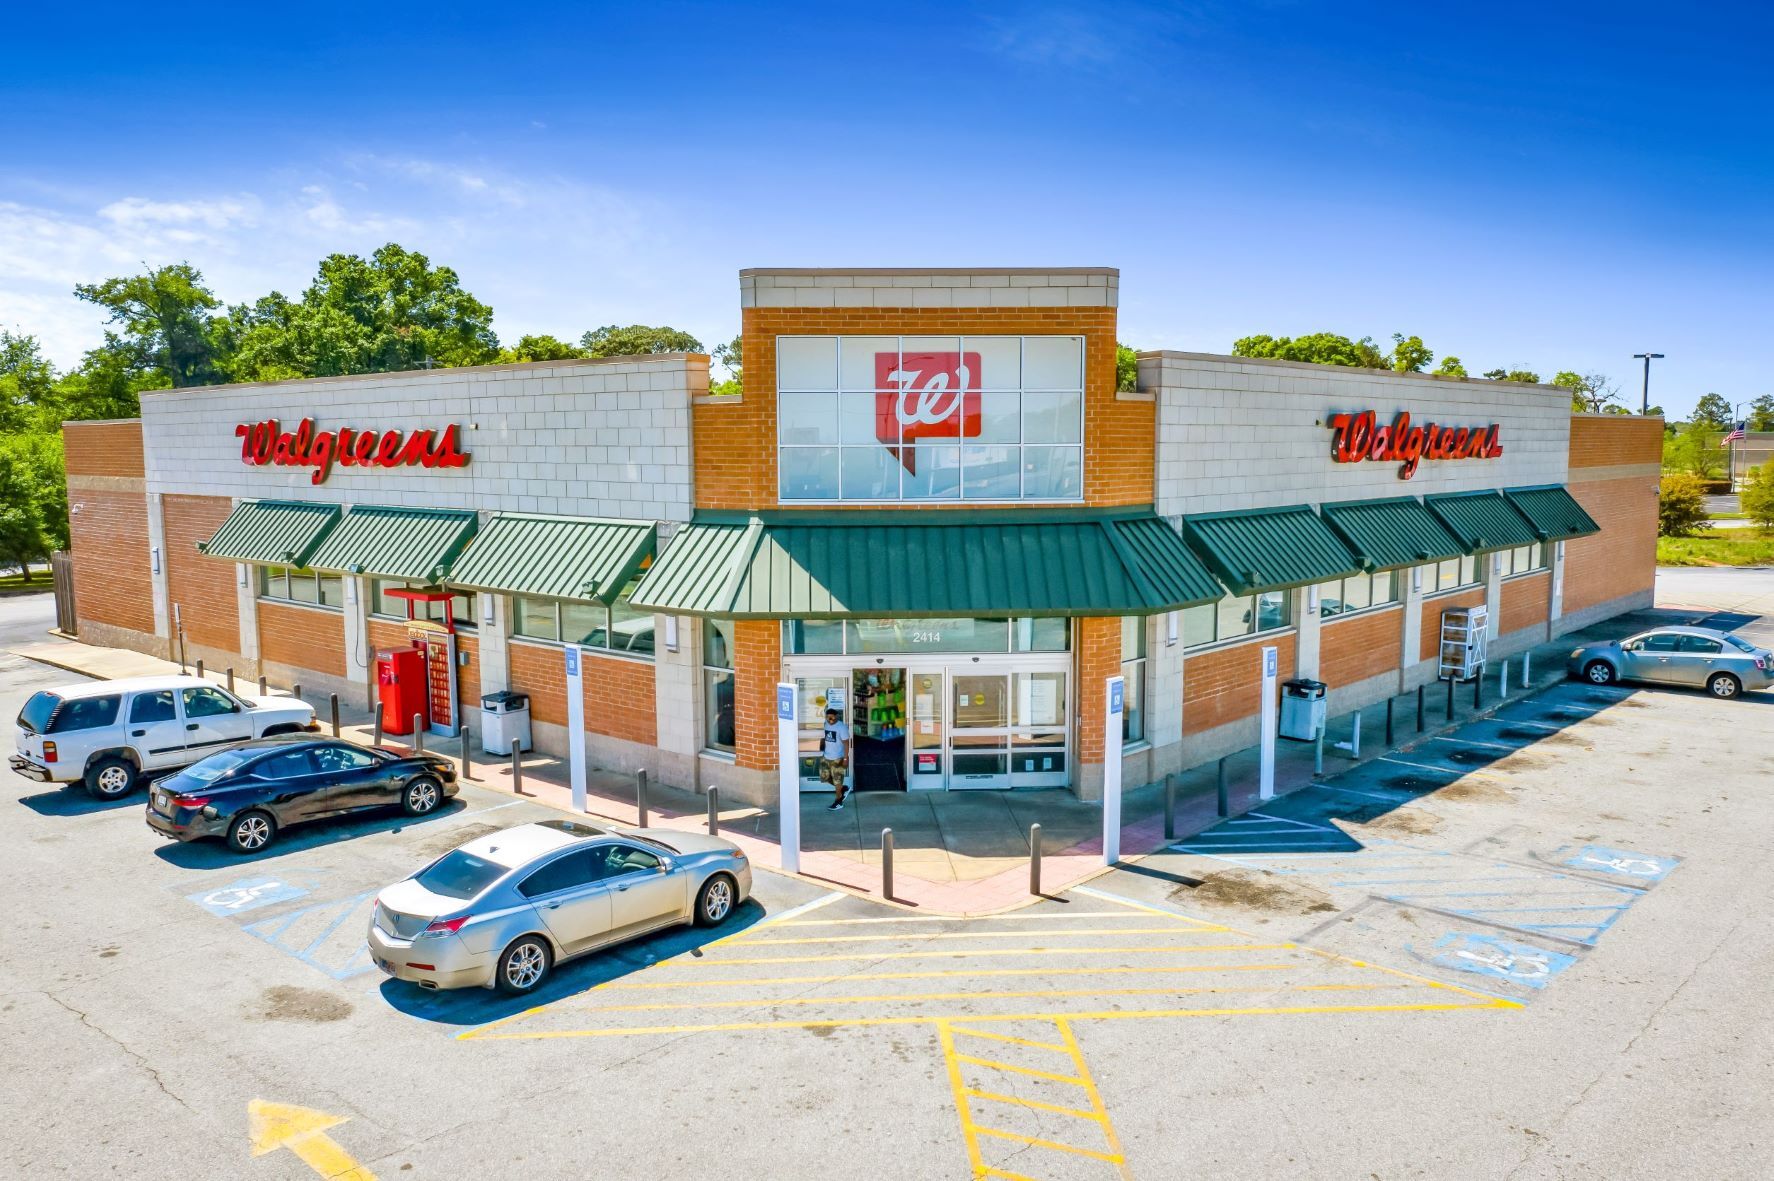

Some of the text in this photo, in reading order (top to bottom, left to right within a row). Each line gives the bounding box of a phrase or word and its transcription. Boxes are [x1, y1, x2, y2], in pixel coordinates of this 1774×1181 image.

[887, 364, 970, 425] W
[235, 417, 471, 485] Walgreens
[1327, 410, 1503, 480] Walgreens
[912, 631, 941, 643] 2414
